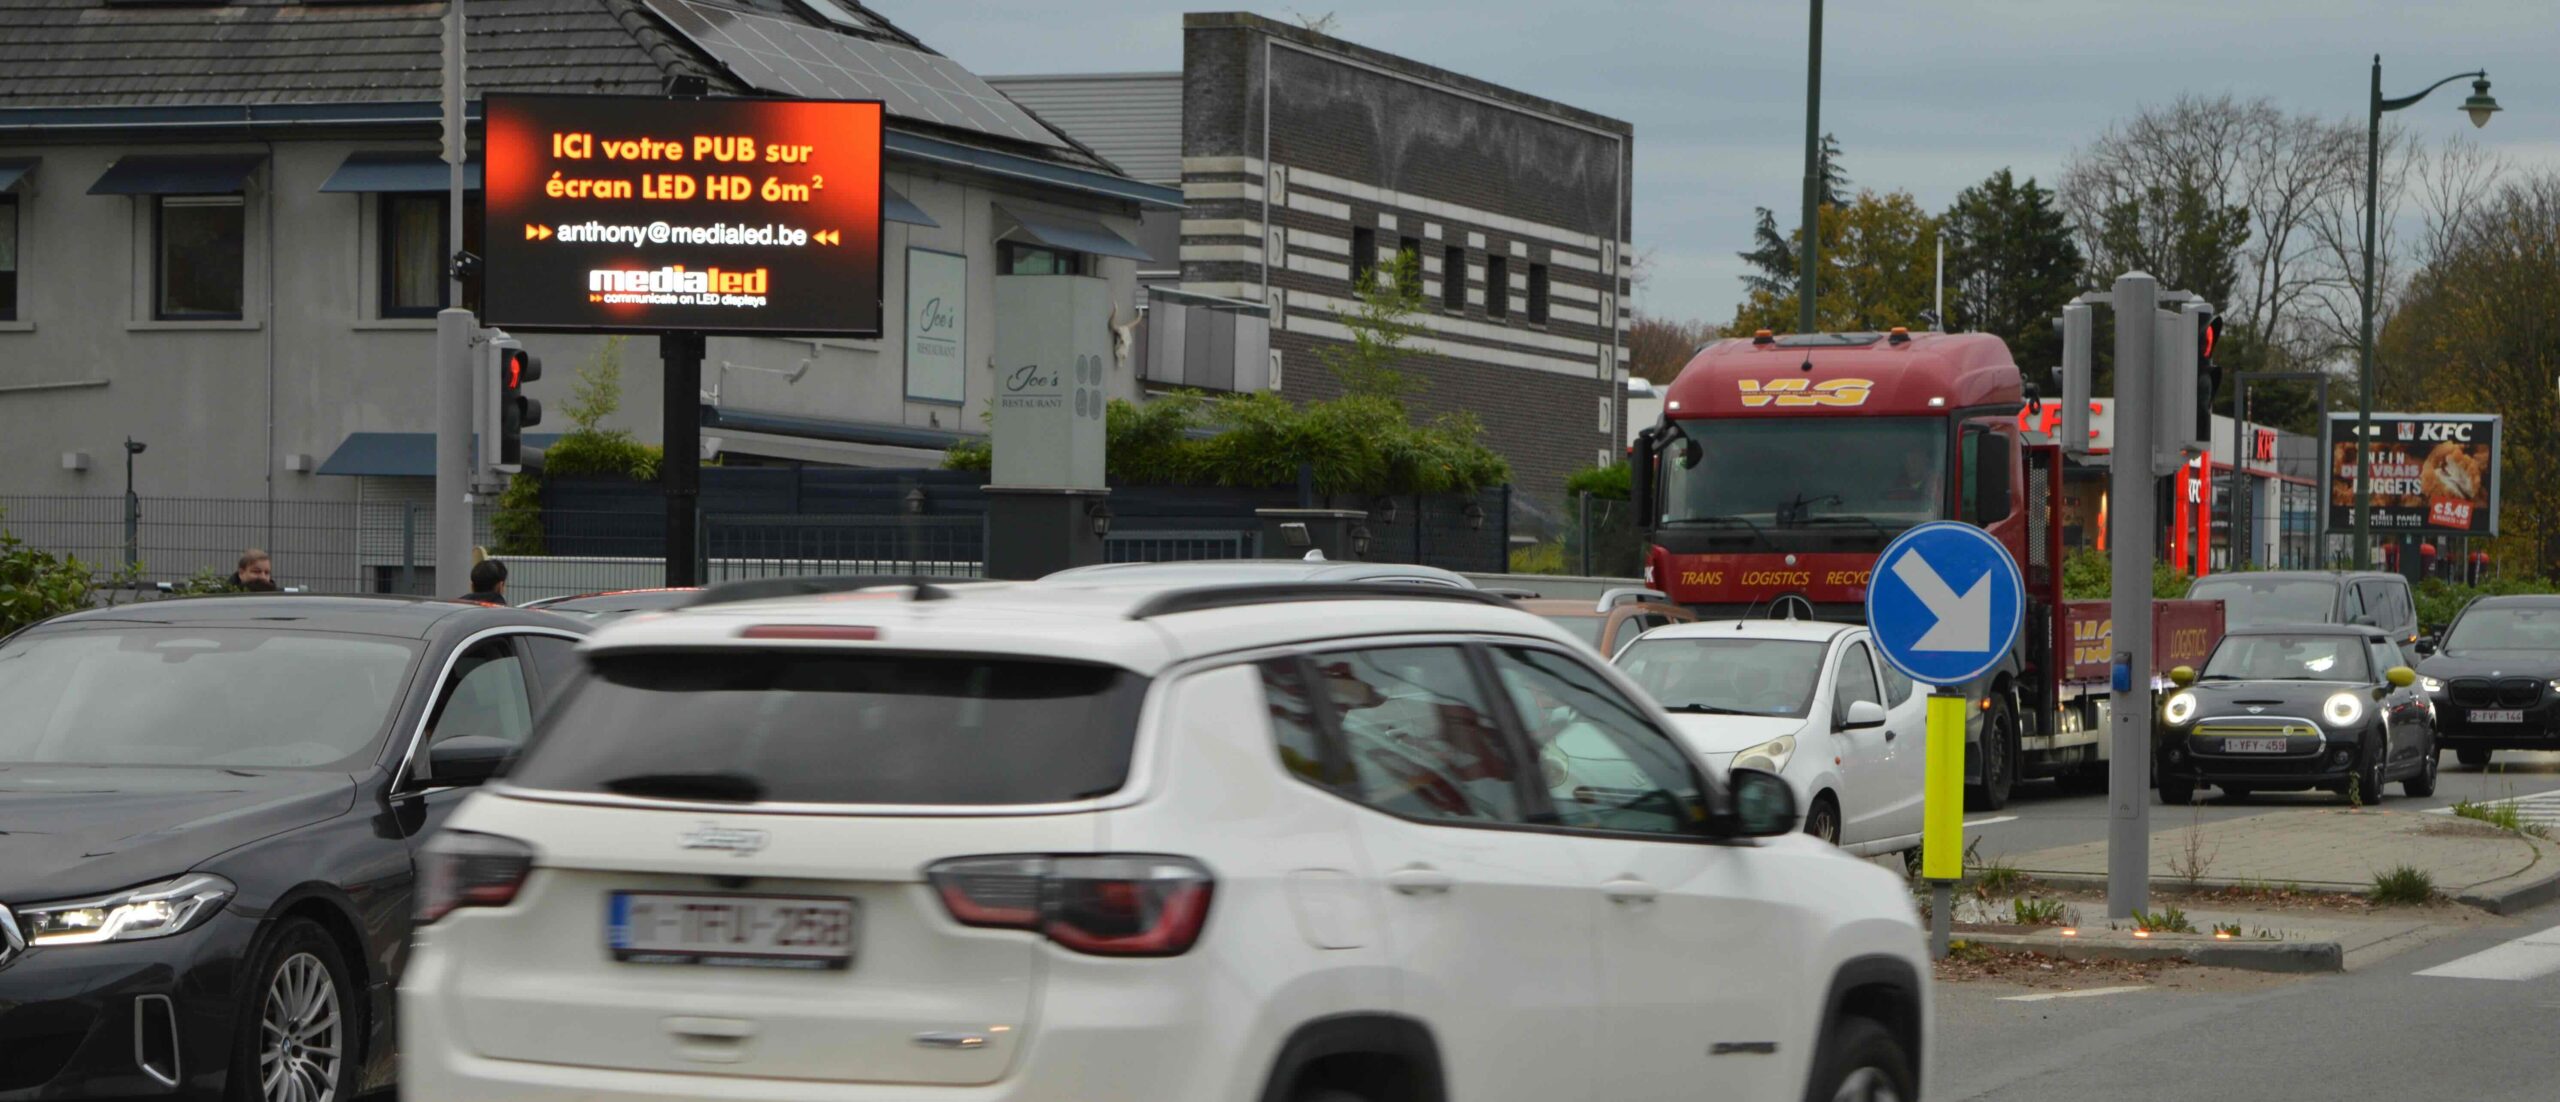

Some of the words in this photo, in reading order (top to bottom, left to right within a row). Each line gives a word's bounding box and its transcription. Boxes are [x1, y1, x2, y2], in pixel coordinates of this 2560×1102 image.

[553, 133, 592, 159] ICI
[602, 137, 683, 161] votre
[694, 136, 755, 161] PUB
[766, 142, 813, 163] sur
[546, 171, 631, 199] écran
[642, 175, 695, 200] LED
[707, 176, 752, 201] HD
[557, 221, 807, 248] anthony@medialed.be
[589, 265, 767, 293] medialed
[604, 294, 677, 304] communicate
[679, 294, 694, 305] on
[697, 294, 719, 305] LED
[721, 294, 766, 307] displays
[920, 297, 954, 332] Joe's
[1006, 364, 1058, 391] Joe's
[1002, 399, 1062, 409] RESTAURANT
[1738, 378, 1875, 406] VLG
[2419, 422, 2473, 441] KFC
[2368, 452, 2405, 464] NFIN
[2373, 465, 2419, 477] VRAIS
[1681, 571, 1723, 585] TRANS
[1741, 571, 1811, 585] LOGISTICS
[1826, 571, 1872, 585] RECYC
[2170, 628, 2207, 660] LOGISTICS
[2228, 741, 2285, 751] 1-YFY-459
